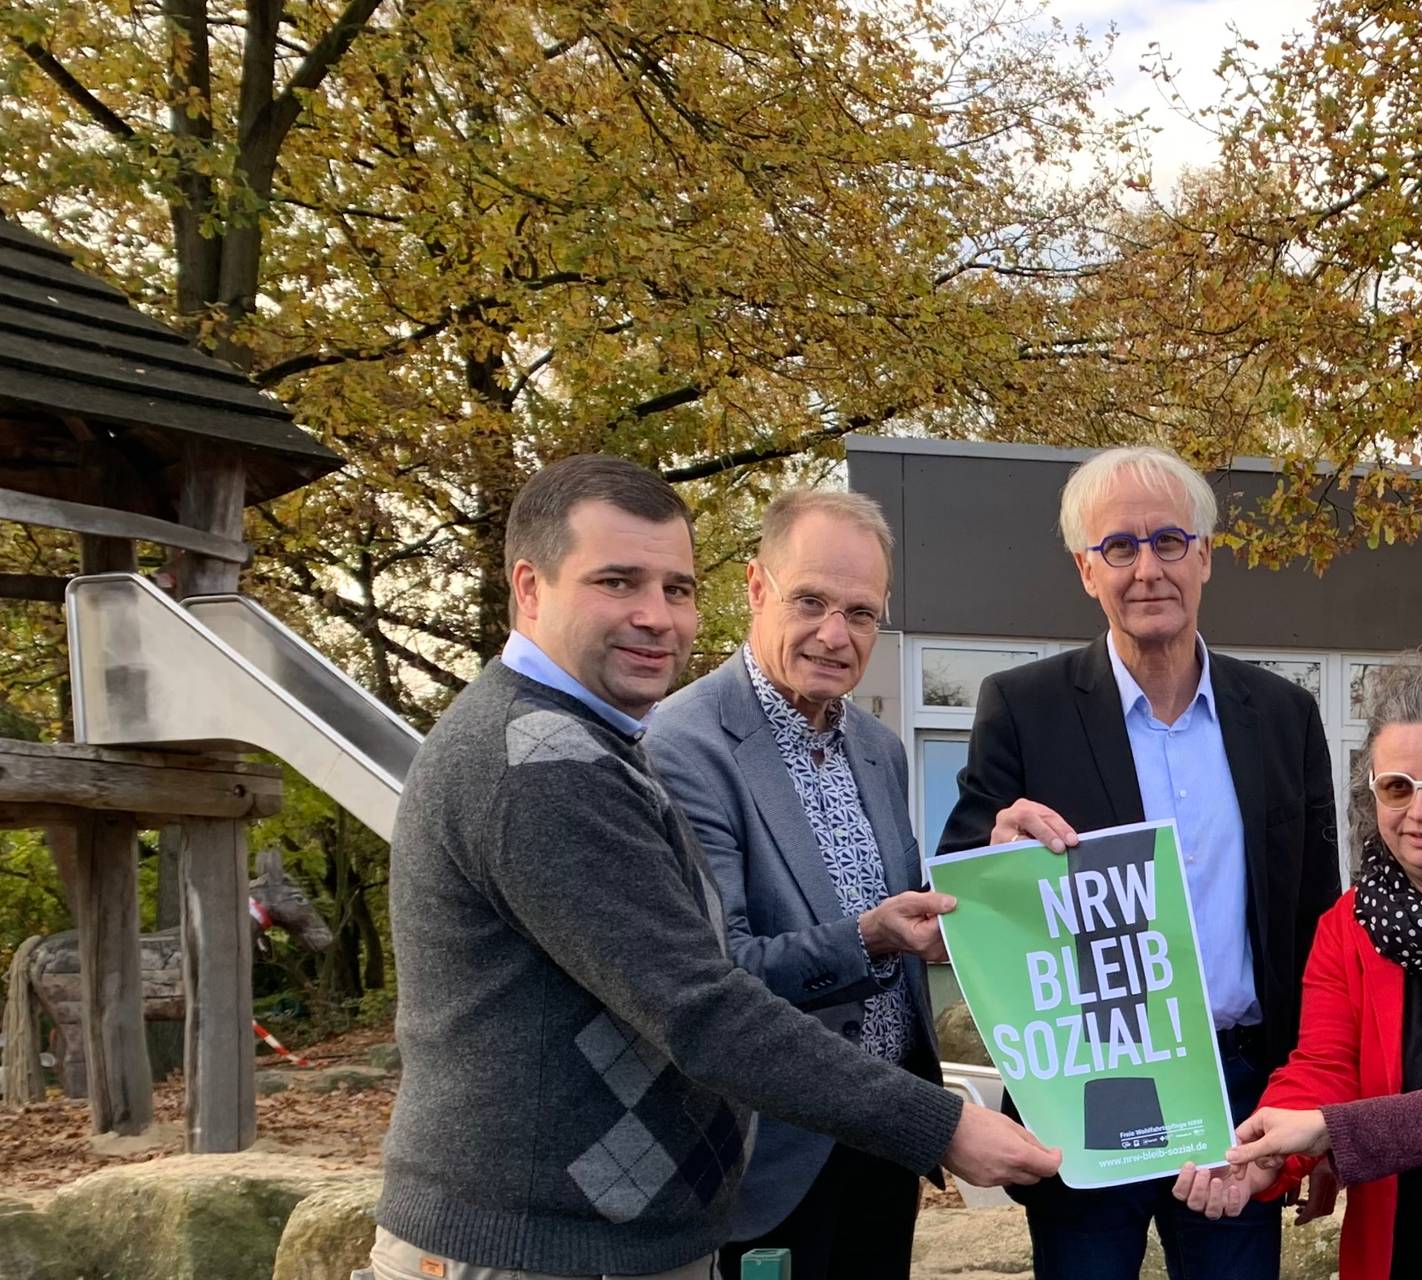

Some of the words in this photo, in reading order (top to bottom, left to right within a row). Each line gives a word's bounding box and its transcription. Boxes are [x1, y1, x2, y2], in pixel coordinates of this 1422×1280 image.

[1037, 860, 1157, 938] NRW
[1026, 930, 1174, 1011] BLEIB
[992, 997, 1187, 1081] SOZIAL!
[1099, 1142, 1207, 1168] www.nrw-bleib-sozial.de
